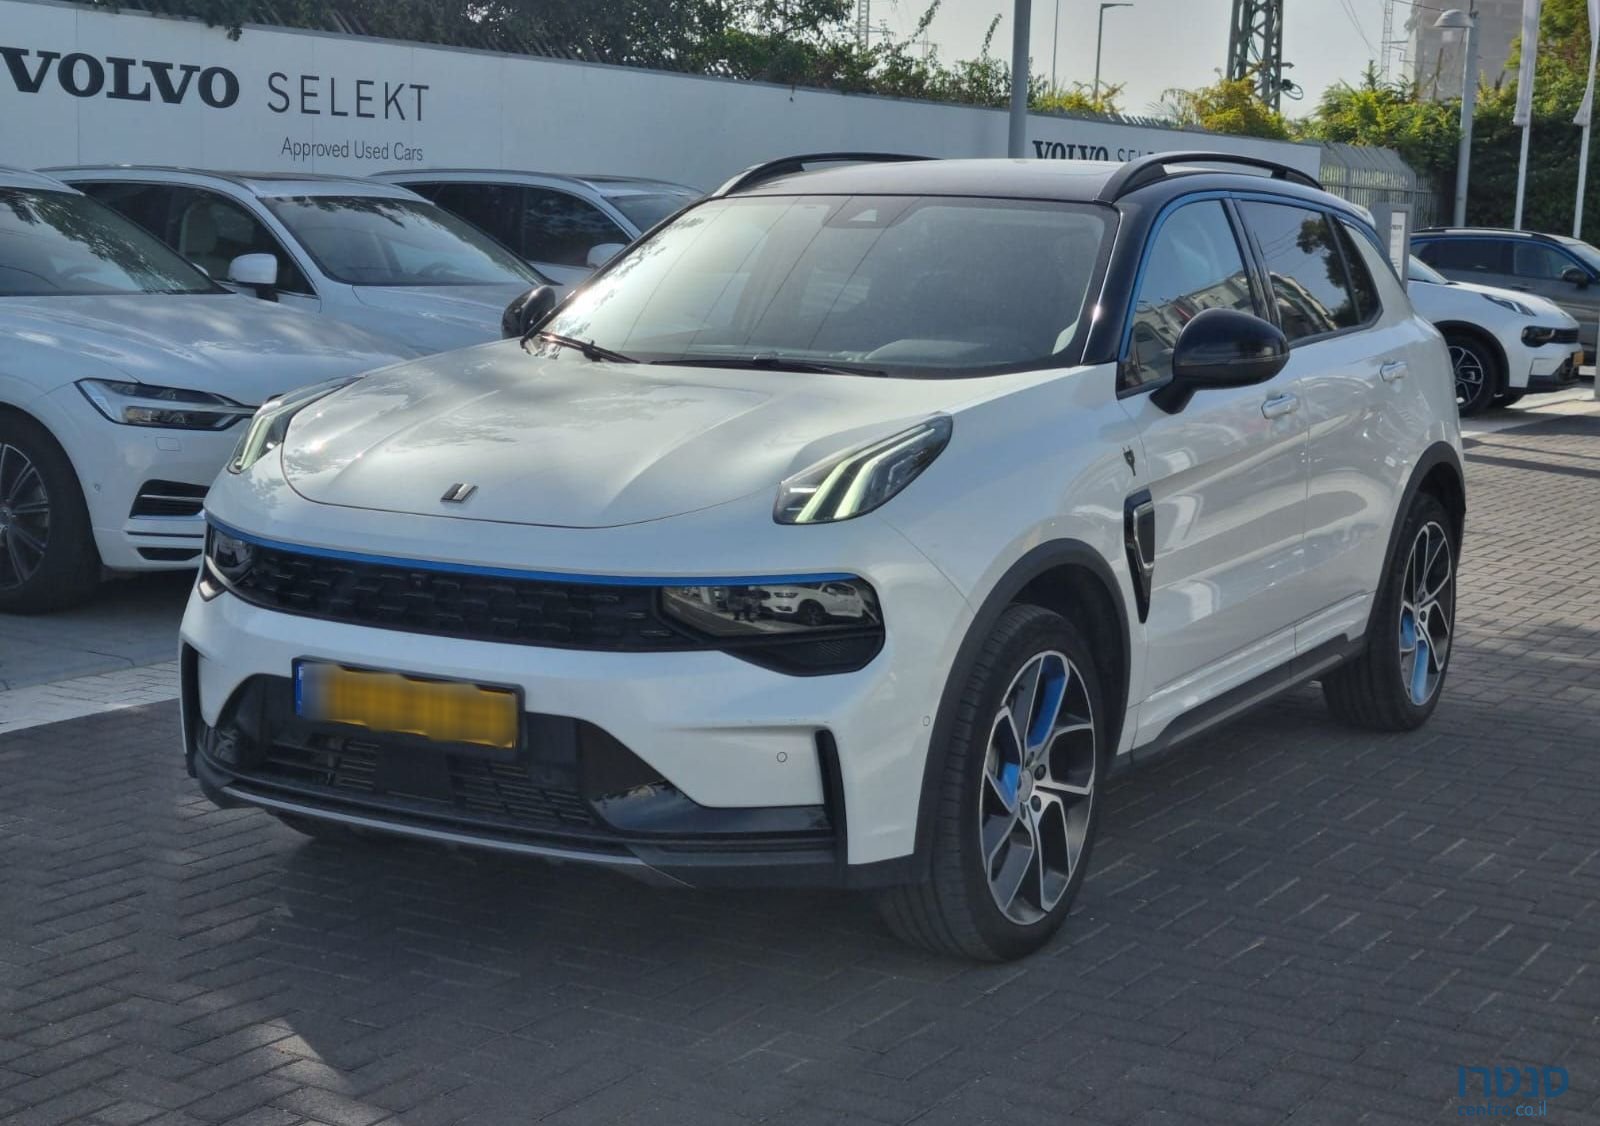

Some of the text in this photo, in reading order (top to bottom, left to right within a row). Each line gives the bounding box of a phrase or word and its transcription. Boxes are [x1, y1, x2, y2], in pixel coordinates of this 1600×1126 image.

[0, 46, 430, 121] VOLVO SELEKT
[281, 136, 424, 162] Approved Used Cars
